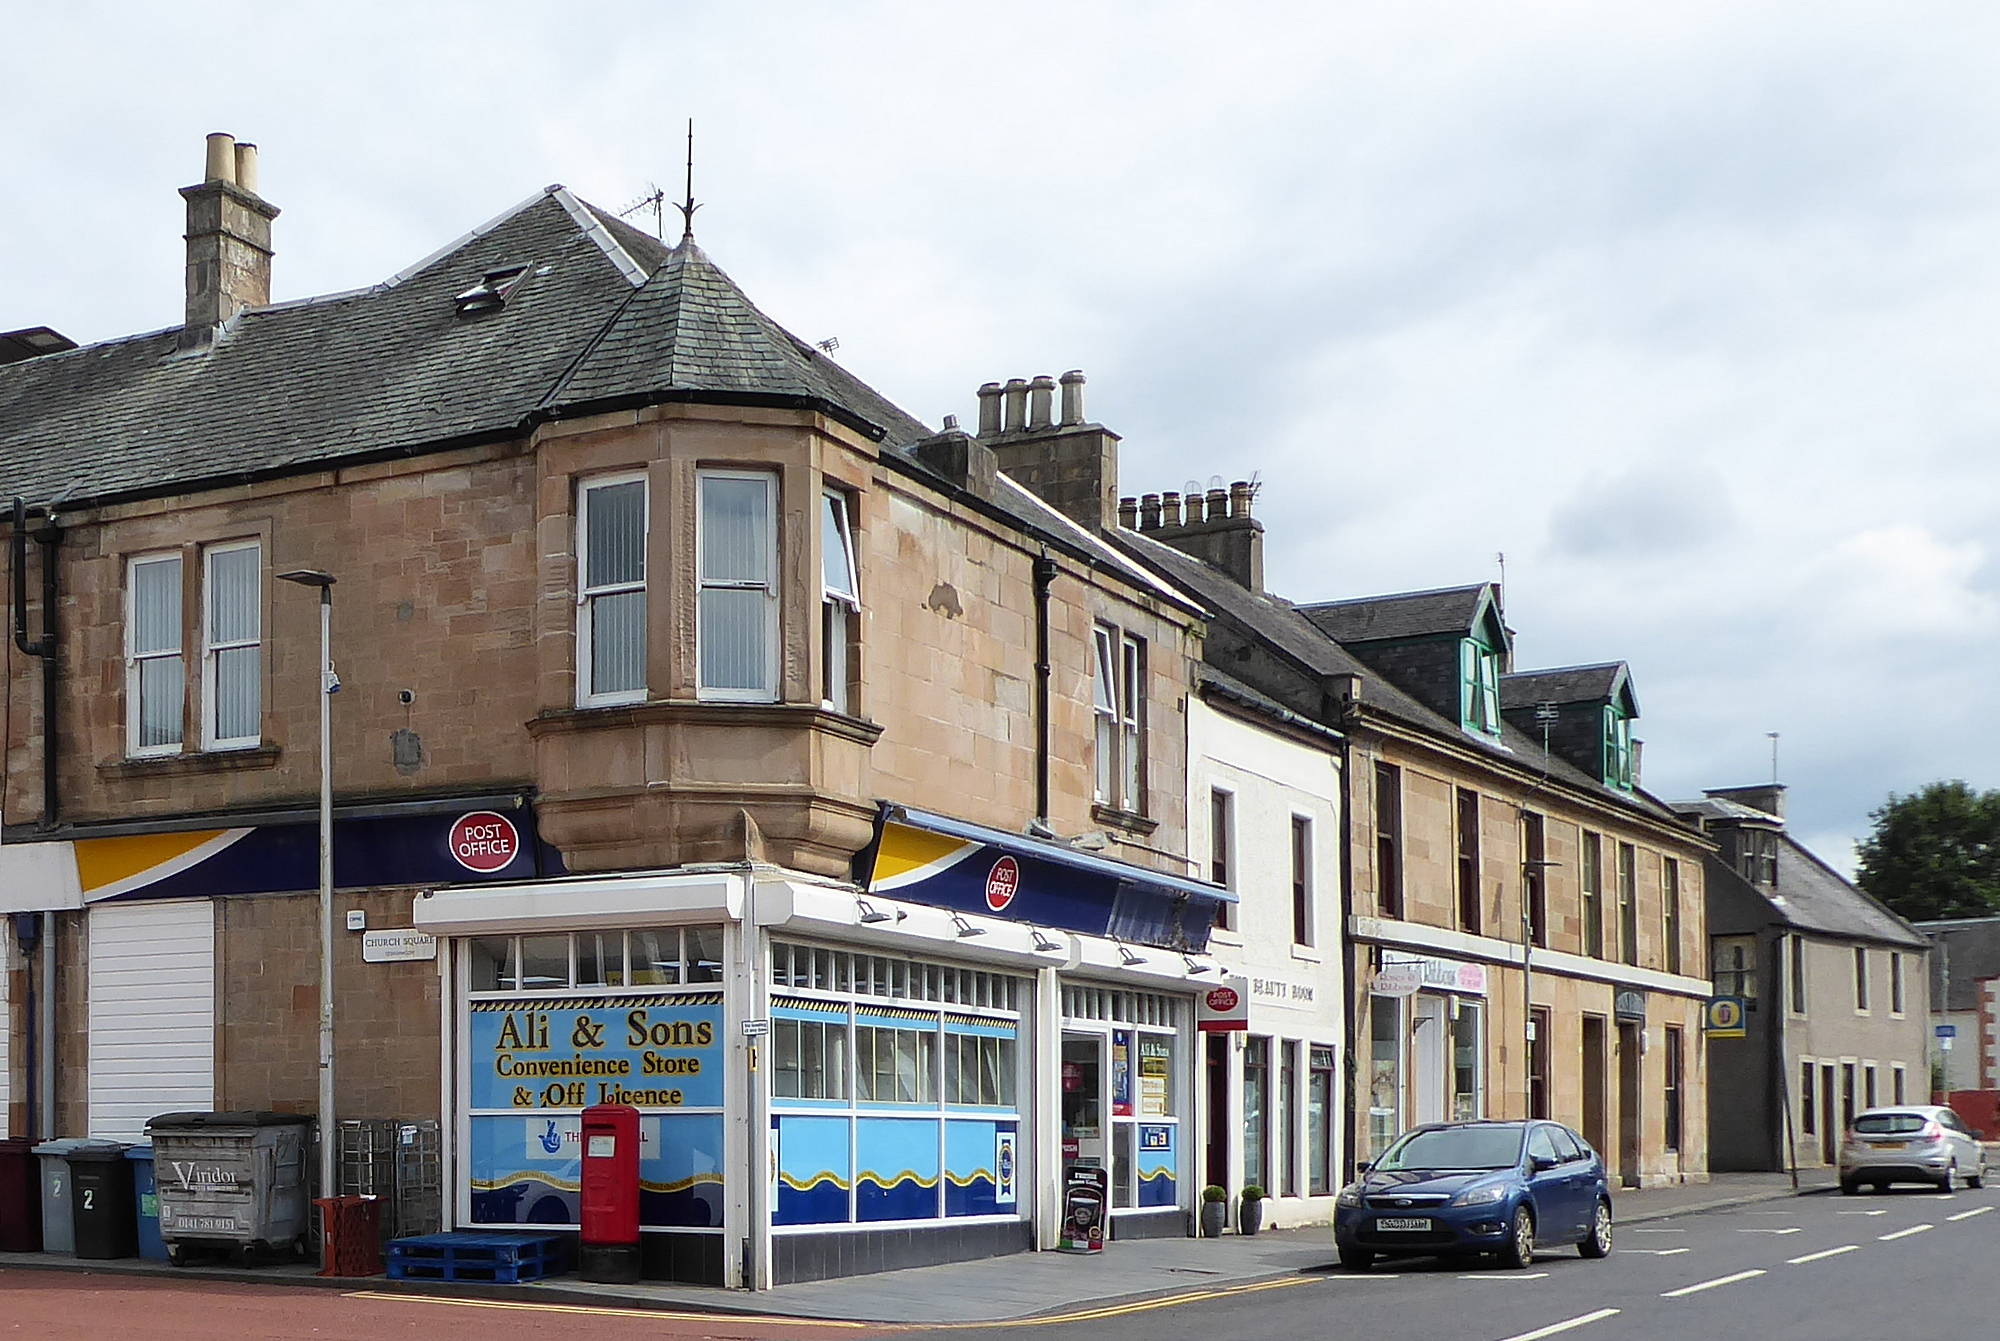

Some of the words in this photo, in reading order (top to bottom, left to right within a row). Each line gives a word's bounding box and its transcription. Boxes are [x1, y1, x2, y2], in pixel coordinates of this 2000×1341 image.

[465, 823, 502, 841] POST
[459, 839, 511, 857] OFFICE
[996, 867, 1014, 882] POST
[989, 881, 1013, 897] OFFICE
[365, 937, 400, 948] CHURCH
[403, 935, 433, 946] SQUARE
[1208, 998, 1235, 1006] OFFICE
[1212, 990, 1233, 999] POST
[495, 1010, 549, 1051] Ali
[571, 1015, 605, 1049] &
[627, 1009, 713, 1047] Sons
[496, 1053, 630, 1077] Convenience
[642, 1050, 700, 1075] Store
[513, 1086, 533, 1106] &
[546, 1081, 585, 1106] Off
[599, 1082, 682, 1105] Licence
[565, 1131, 582, 1143] TH
[171, 1161, 238, 1190] Viridor
[53, 1178, 62, 1198] 2
[83, 1189, 94, 1210] 2
[178, 1217, 198, 1229] 0141
[199, 1218, 214, 1230] 781
[215, 1218, 235, 1231] 9151
